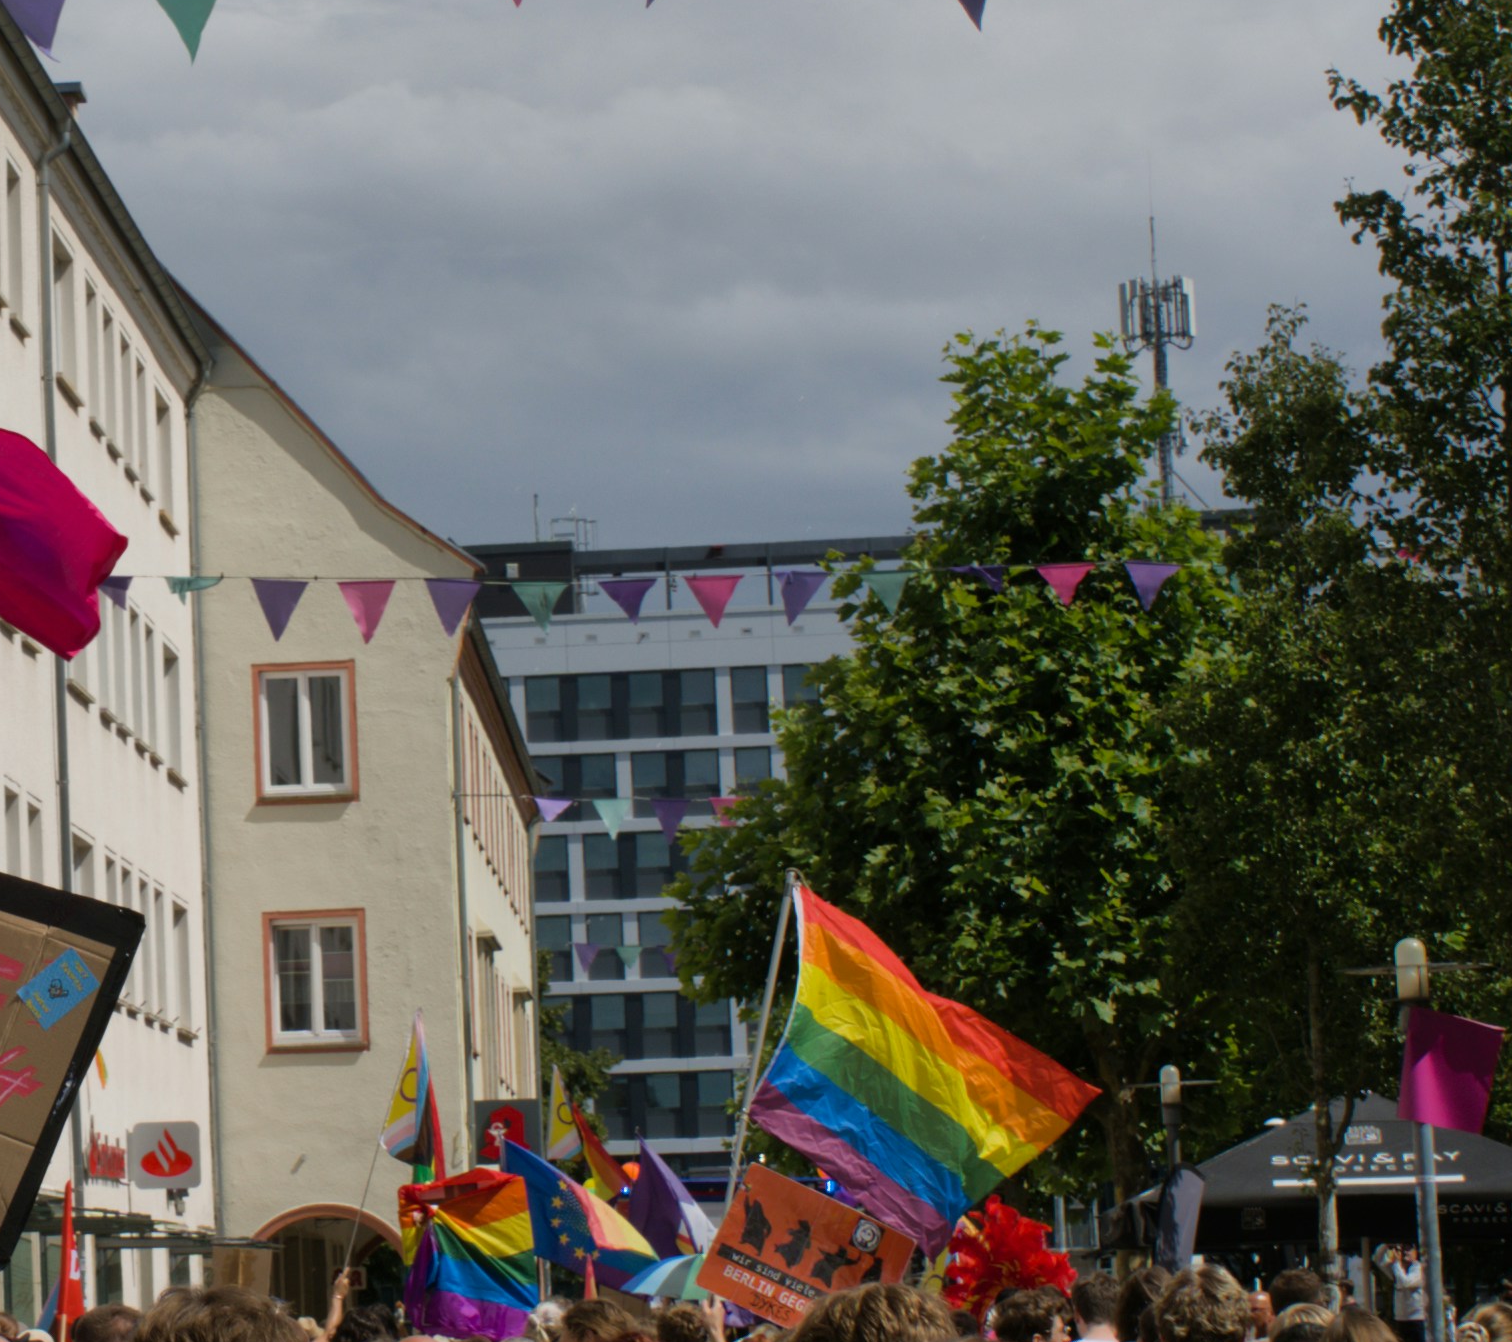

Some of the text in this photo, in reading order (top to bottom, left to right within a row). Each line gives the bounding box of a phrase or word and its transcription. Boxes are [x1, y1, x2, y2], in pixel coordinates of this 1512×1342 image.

[731, 1251, 752, 1267] wir
[755, 1262, 781, 1282] sind
[722, 1263, 810, 1315] BERLIN GEG
